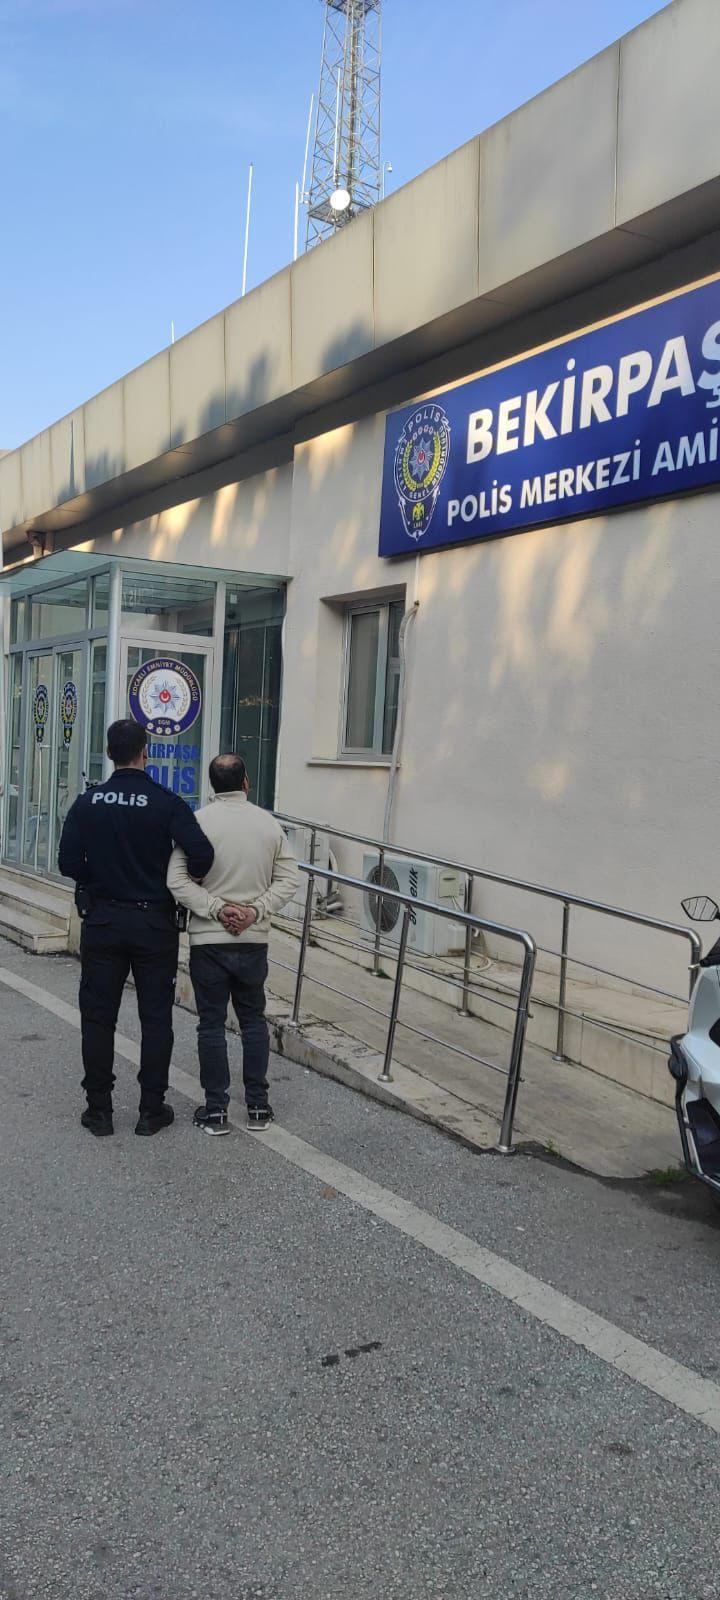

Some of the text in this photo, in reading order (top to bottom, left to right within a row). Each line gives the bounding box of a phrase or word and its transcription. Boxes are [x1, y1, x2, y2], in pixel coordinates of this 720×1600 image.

[408, 407, 440, 433] POLİS
[447, 417, 718, 527] POLİS MERKEZİ AMİ
[91, 791, 148, 807] POLİS
[409, 866, 419, 926] arelik
